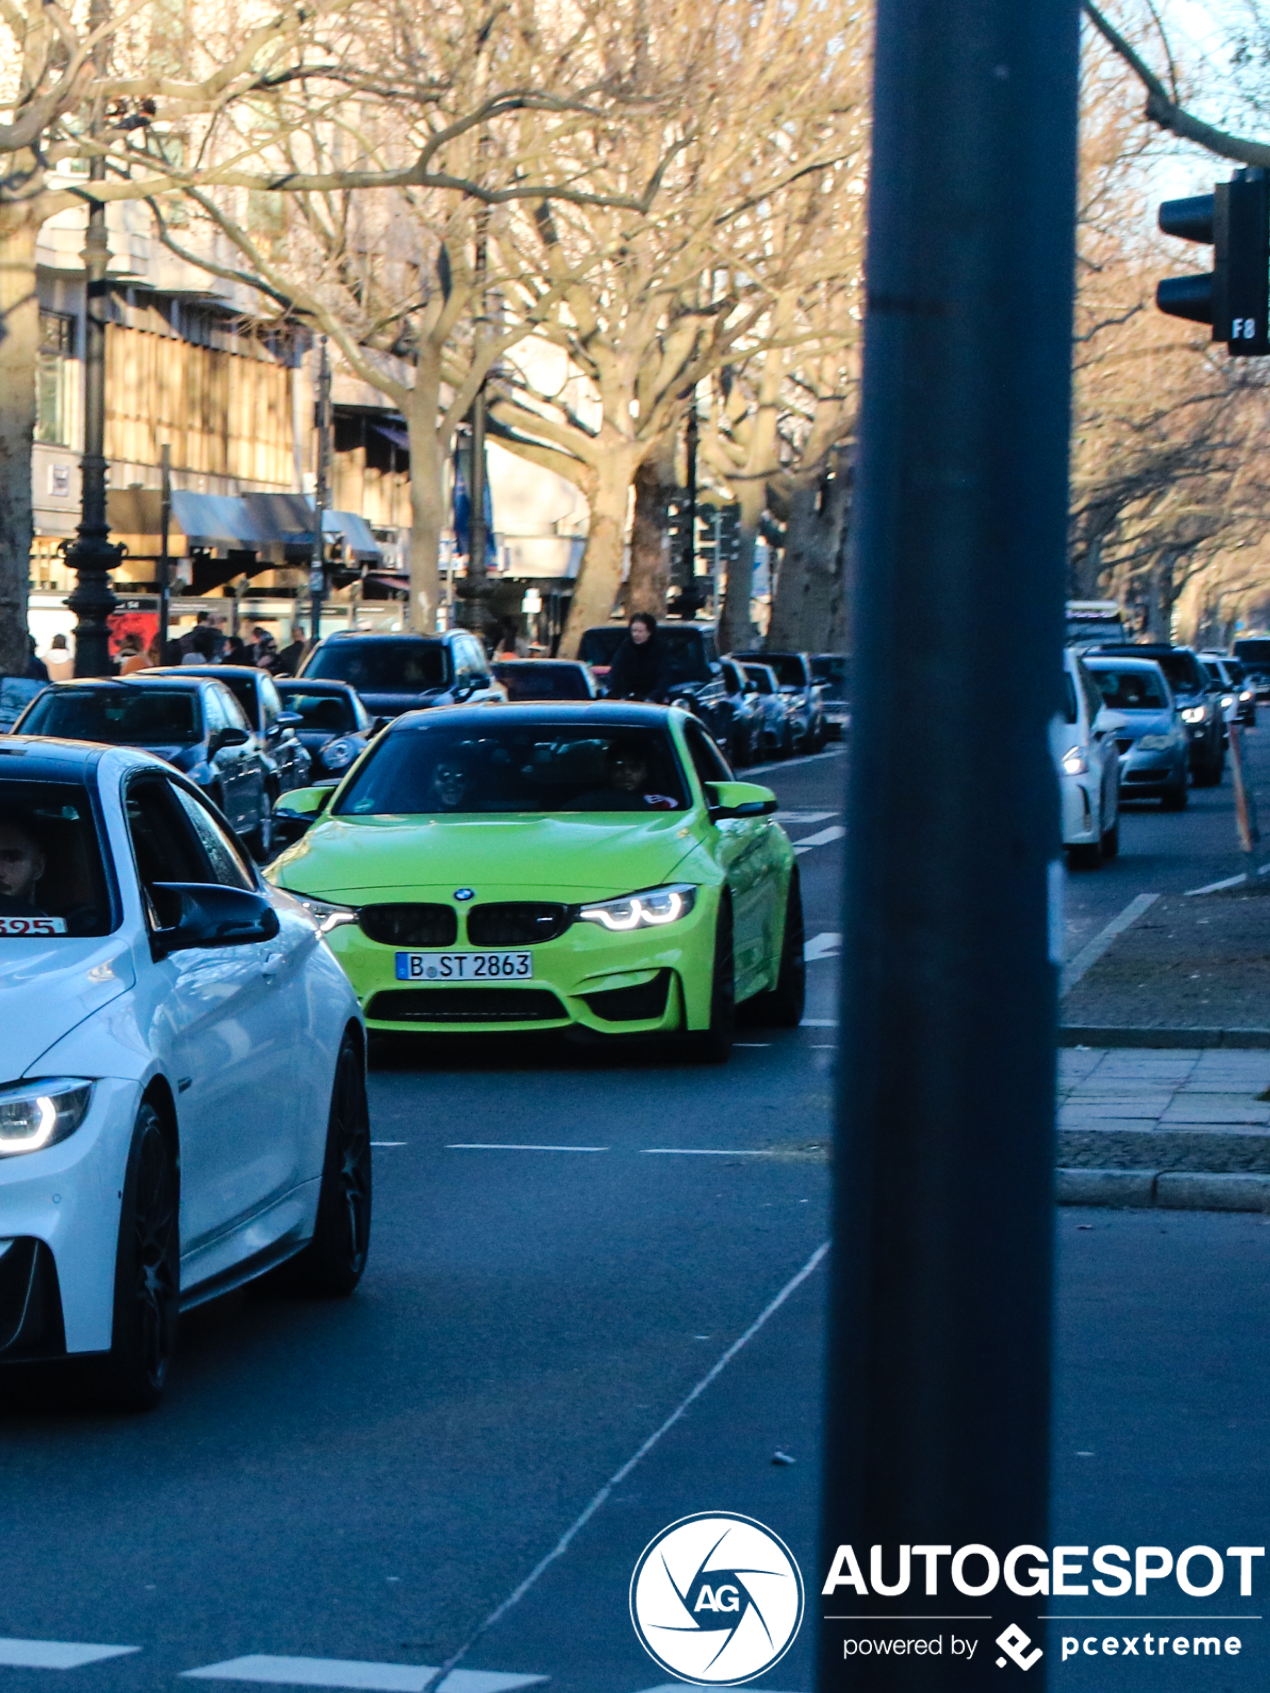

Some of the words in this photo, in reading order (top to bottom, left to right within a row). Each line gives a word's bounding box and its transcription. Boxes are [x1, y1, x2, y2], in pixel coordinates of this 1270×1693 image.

[411, 956, 424, 976] B
[440, 956, 467, 976] ST
[473, 955, 529, 976] 2863
